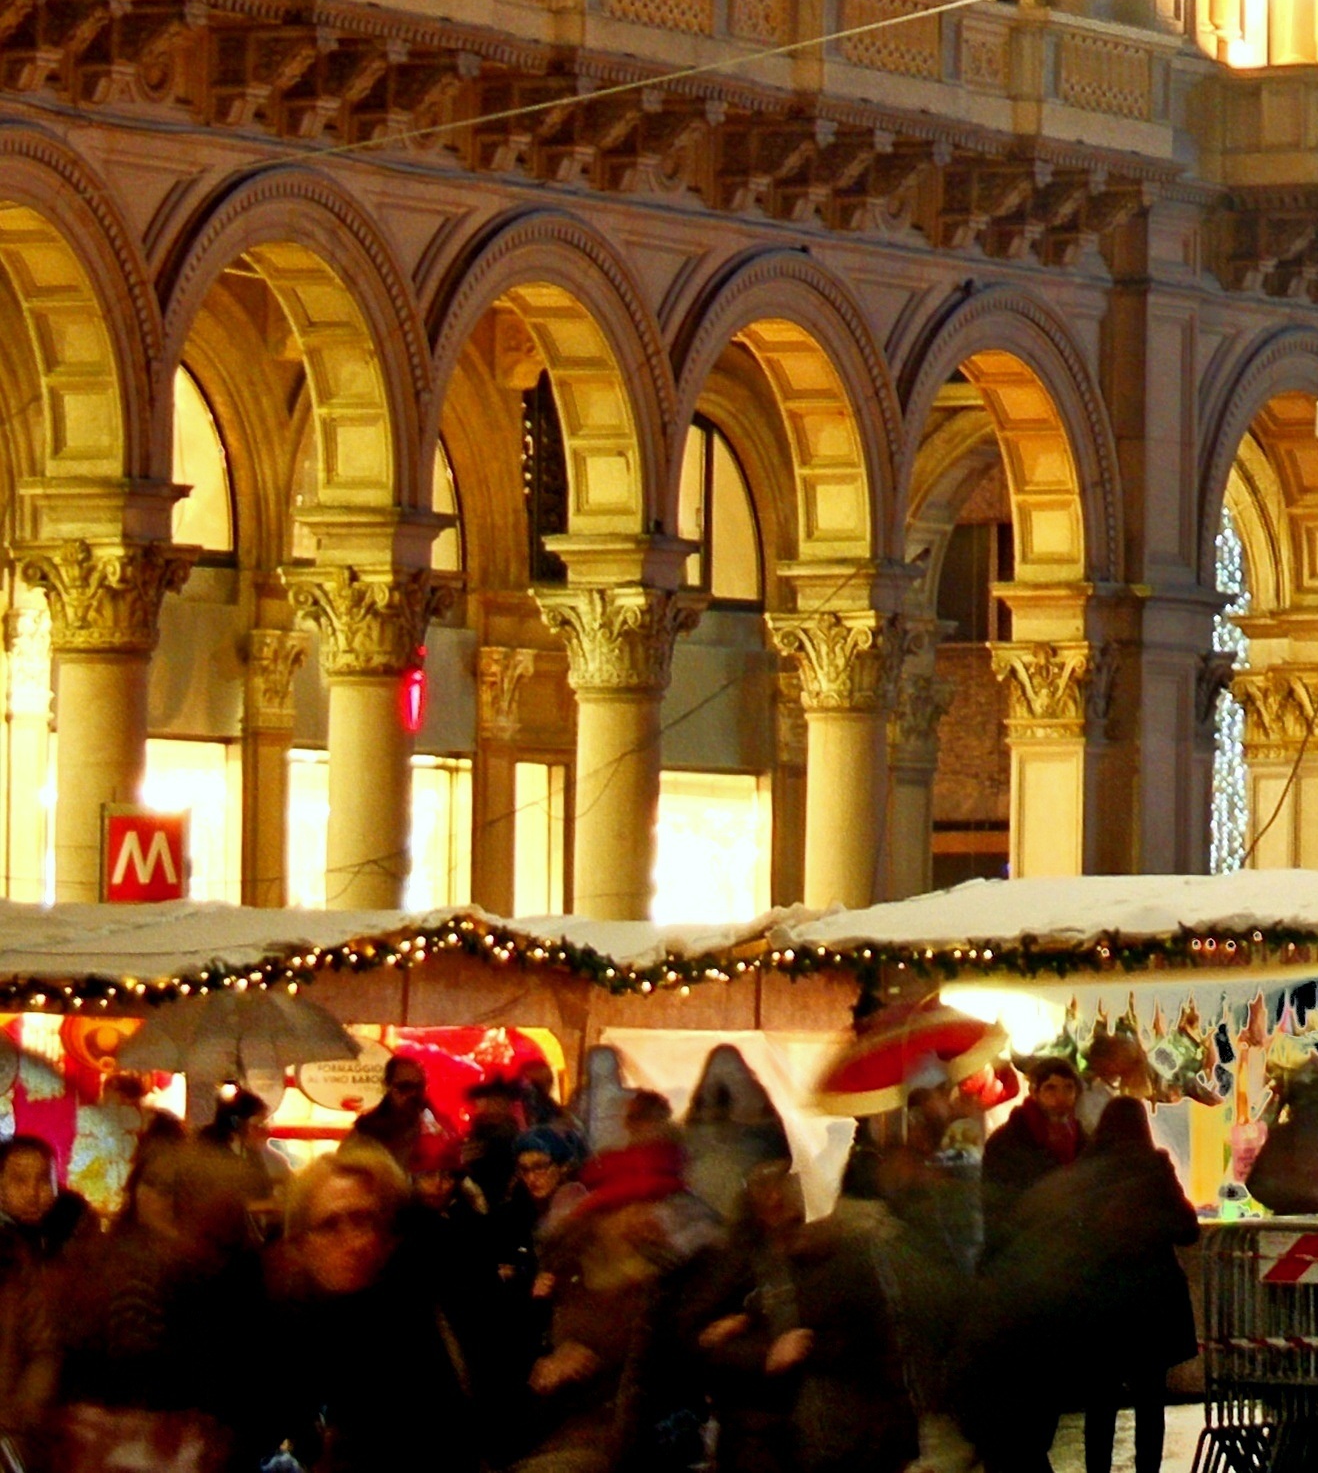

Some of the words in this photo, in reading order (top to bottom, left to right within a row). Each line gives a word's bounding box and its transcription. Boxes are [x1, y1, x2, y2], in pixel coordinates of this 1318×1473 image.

[112, 831, 177, 885] M
[317, 1064, 384, 1073] FORMAGGIO
[352, 1075, 384, 1084] BARO
